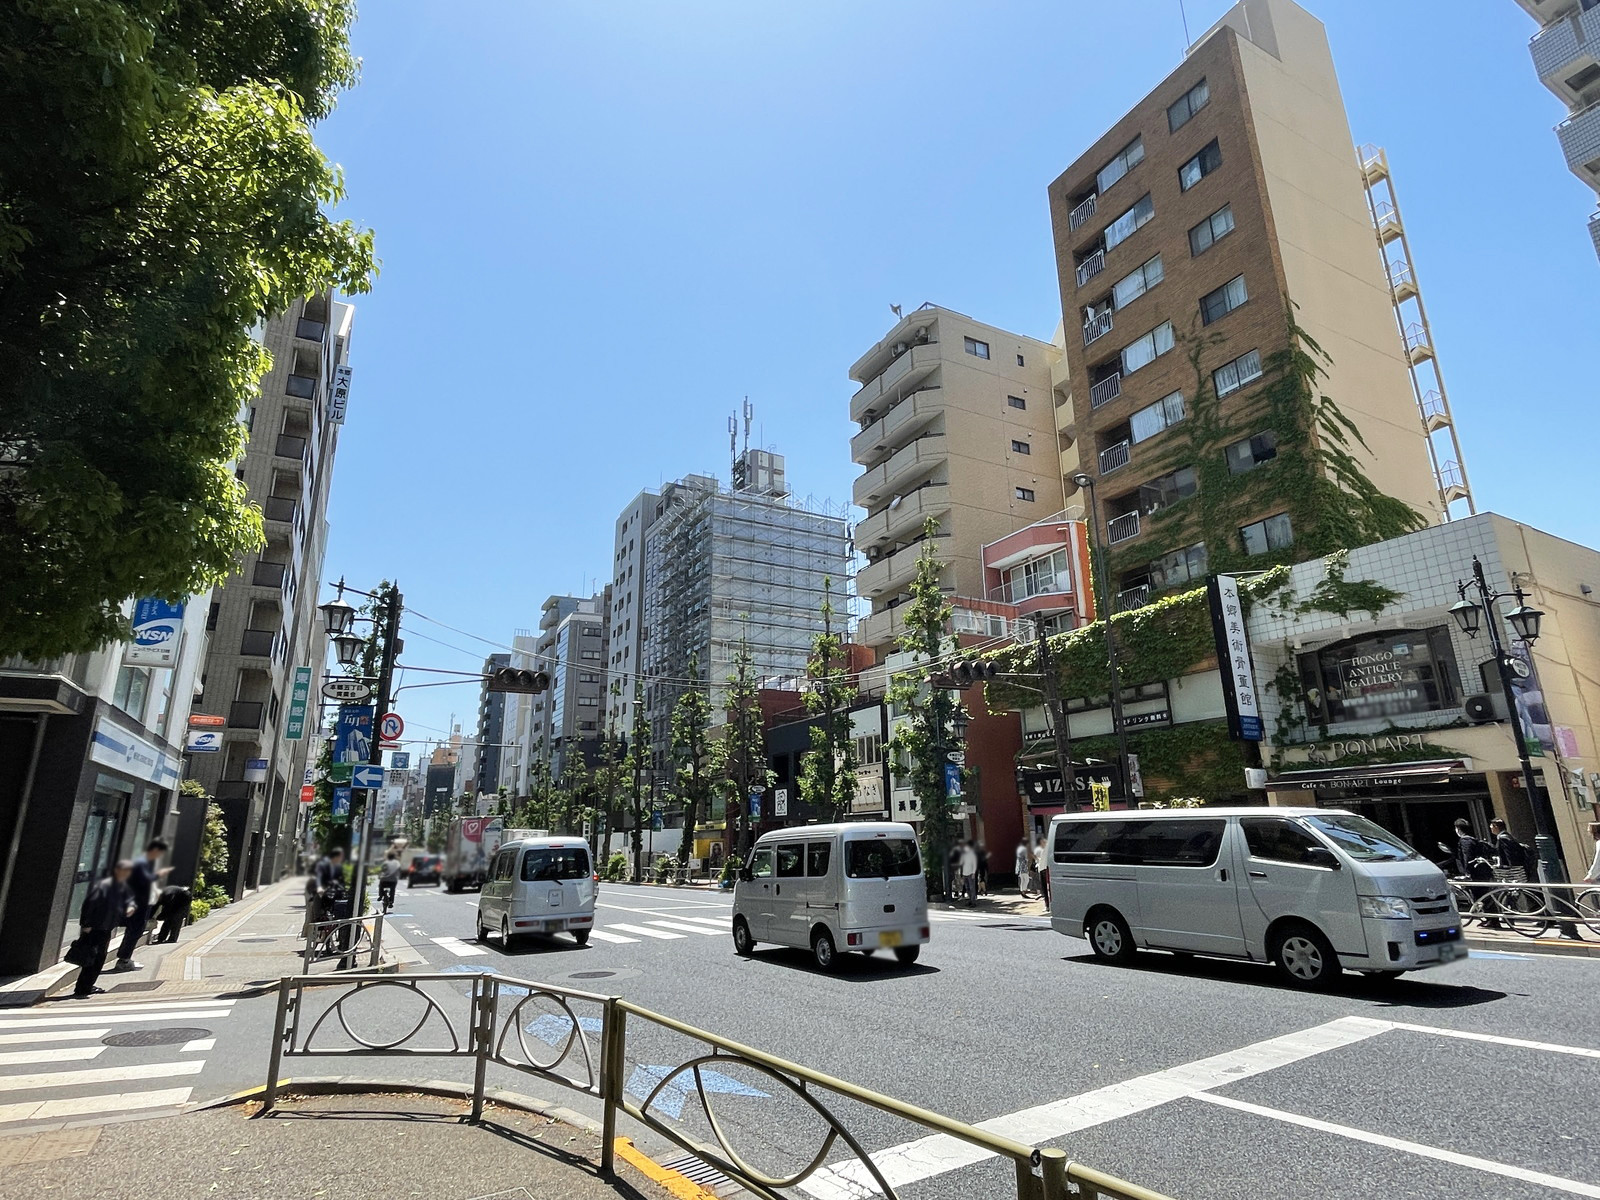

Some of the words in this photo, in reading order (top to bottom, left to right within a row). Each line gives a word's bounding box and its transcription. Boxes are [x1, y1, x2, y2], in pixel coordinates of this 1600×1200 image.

[331, 377, 348, 420] 大原ビル
[1223, 587, 1253, 706] 本郷美術骨董館
[1351, 651, 1393, 667] HONGO
[1349, 661, 1402, 678] ANTIQUE
[1349, 671, 1404, 688] GALLERY
[1331, 738, 1377, 759] BON
[1384, 733, 1425, 752] ART
[1046, 775, 1096, 793] IZSA
